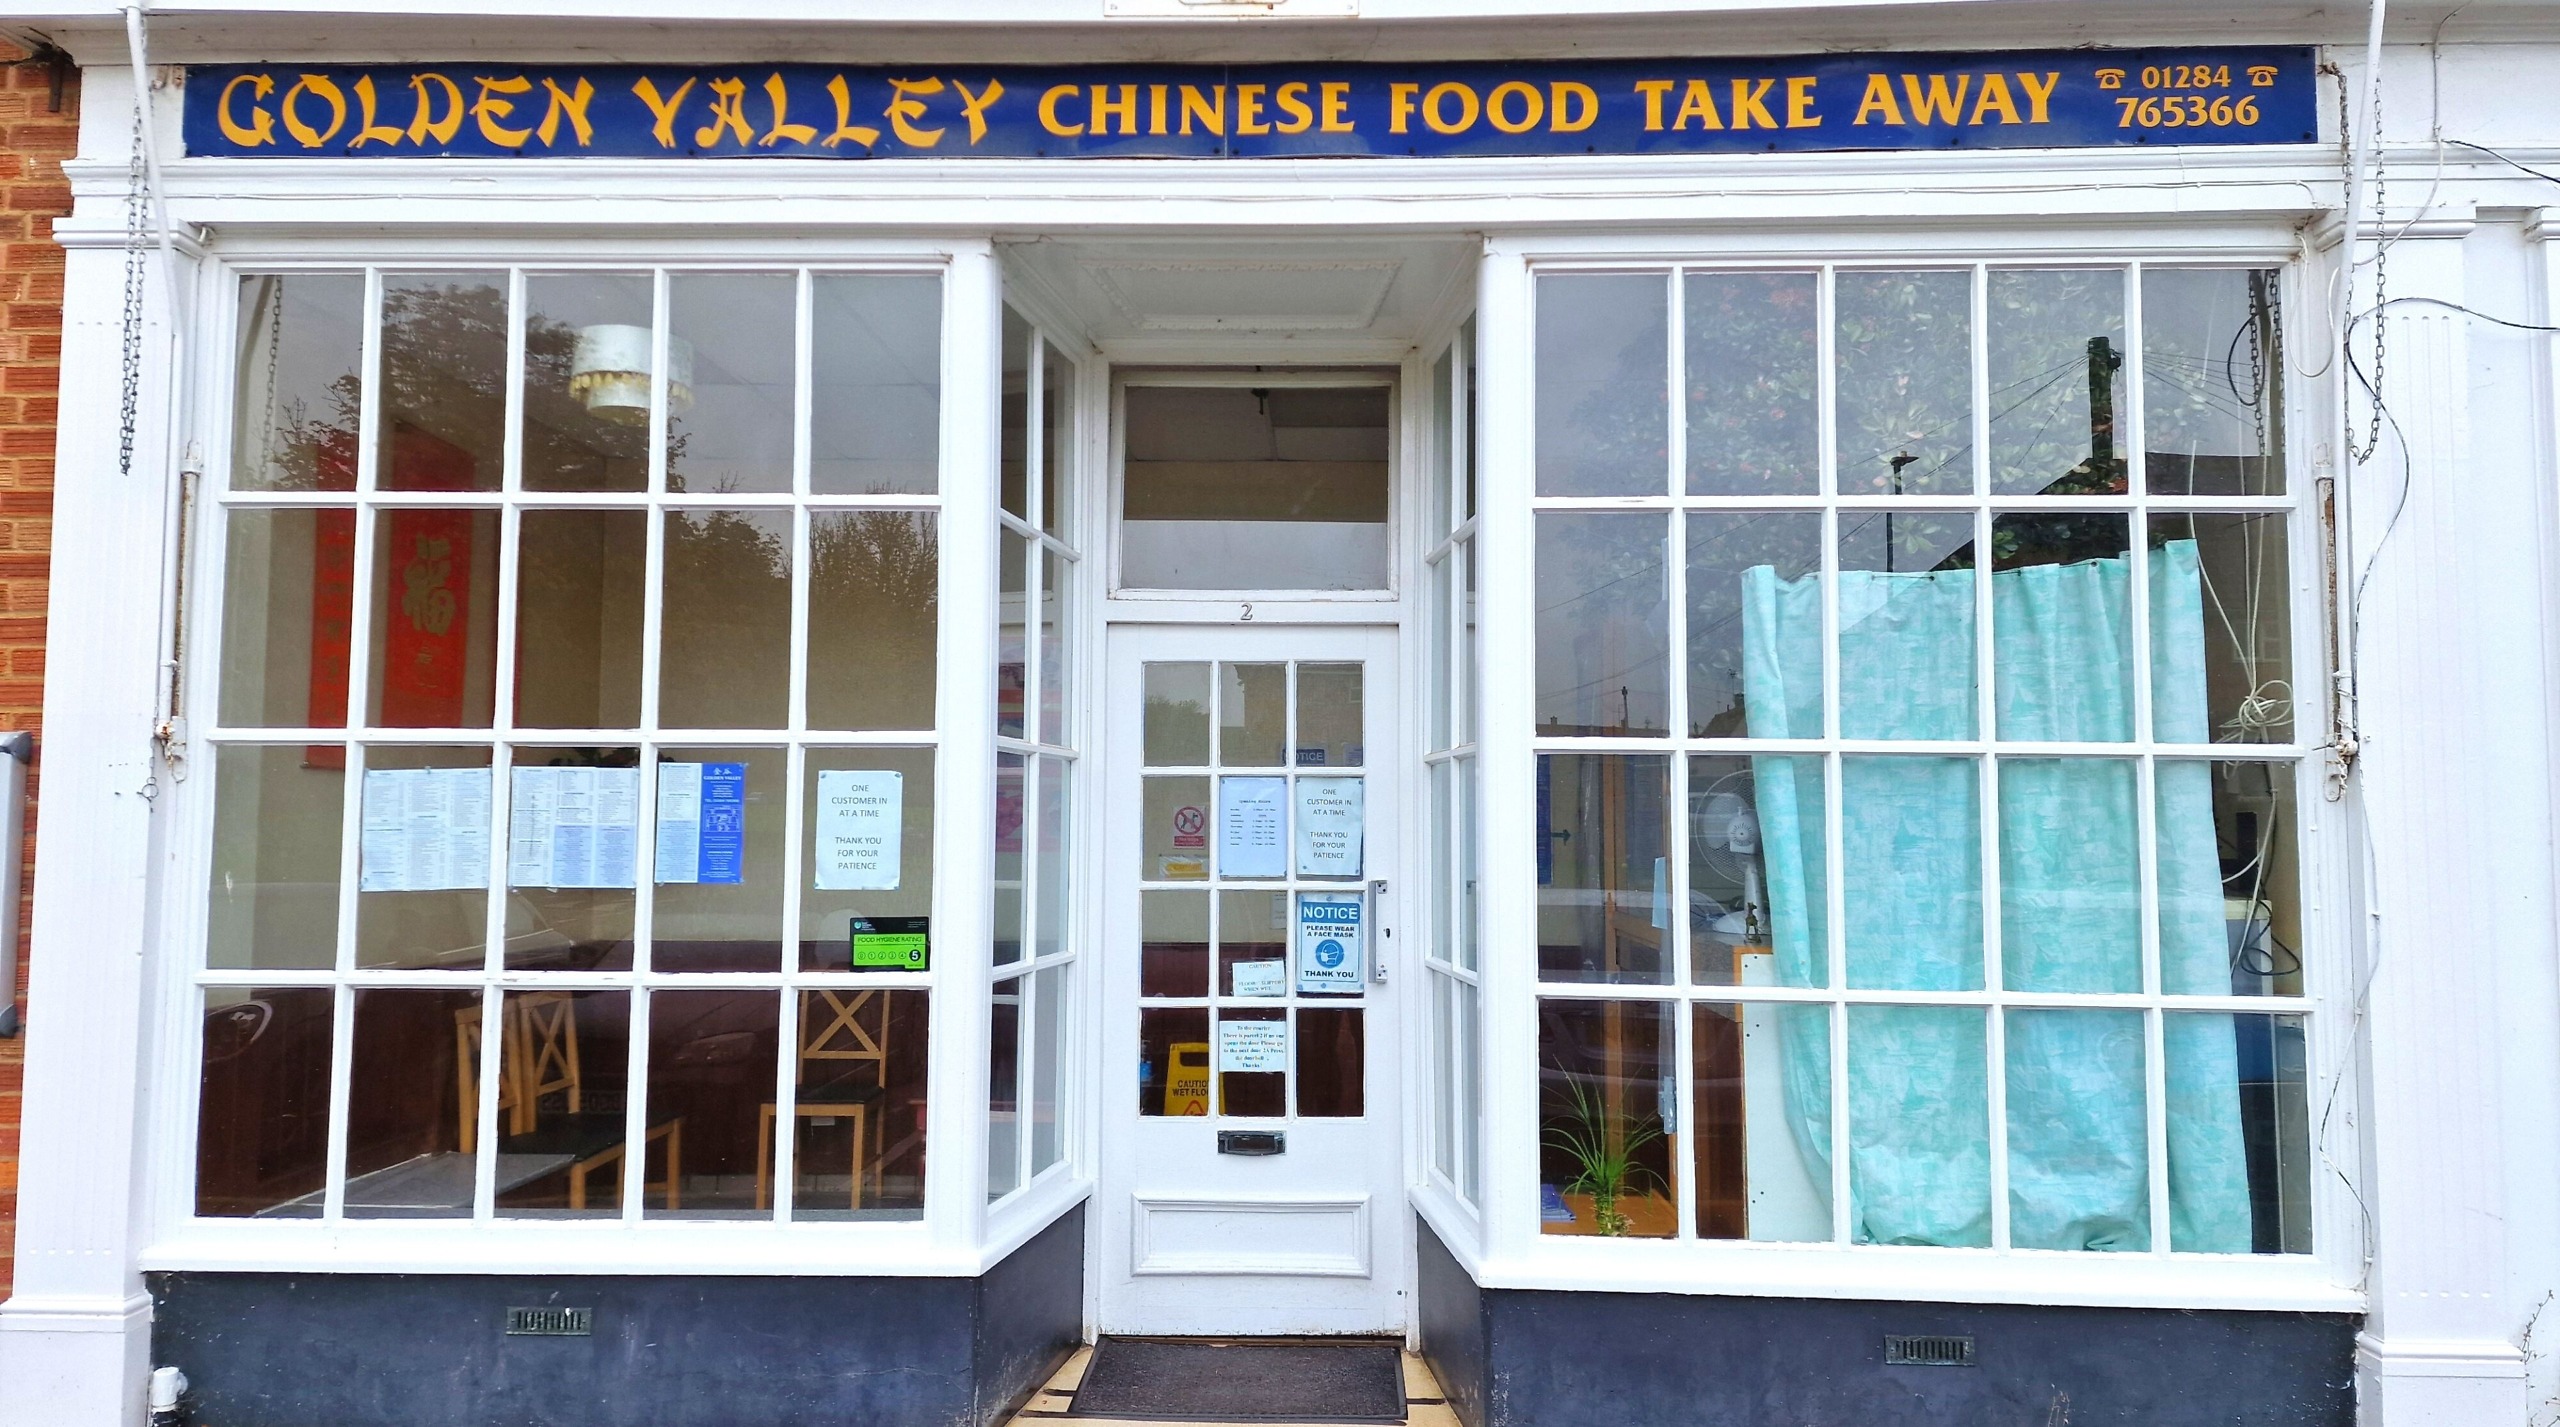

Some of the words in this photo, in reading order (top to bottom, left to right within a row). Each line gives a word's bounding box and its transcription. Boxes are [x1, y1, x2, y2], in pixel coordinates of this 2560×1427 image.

[2141, 65, 2231, 89] 01284
[218, 73, 594, 148] GOLDEN
[632, 74, 1004, 148] VALLEY
[1038, 82, 1354, 136] CHINESE
[1390, 81, 1599, 134] FOOD
[1634, 76, 1821, 131] TAKE
[1856, 72, 2059, 126] AWAY
[2117, 95, 2259, 128] 765366
[1241, 603, 1254, 621] 2
[851, 784, 869, 792] ONE
[839, 809, 849, 817] AT
[1303, 906, 1358, 919] NOTICE
[912, 951, 918, 960] 5
